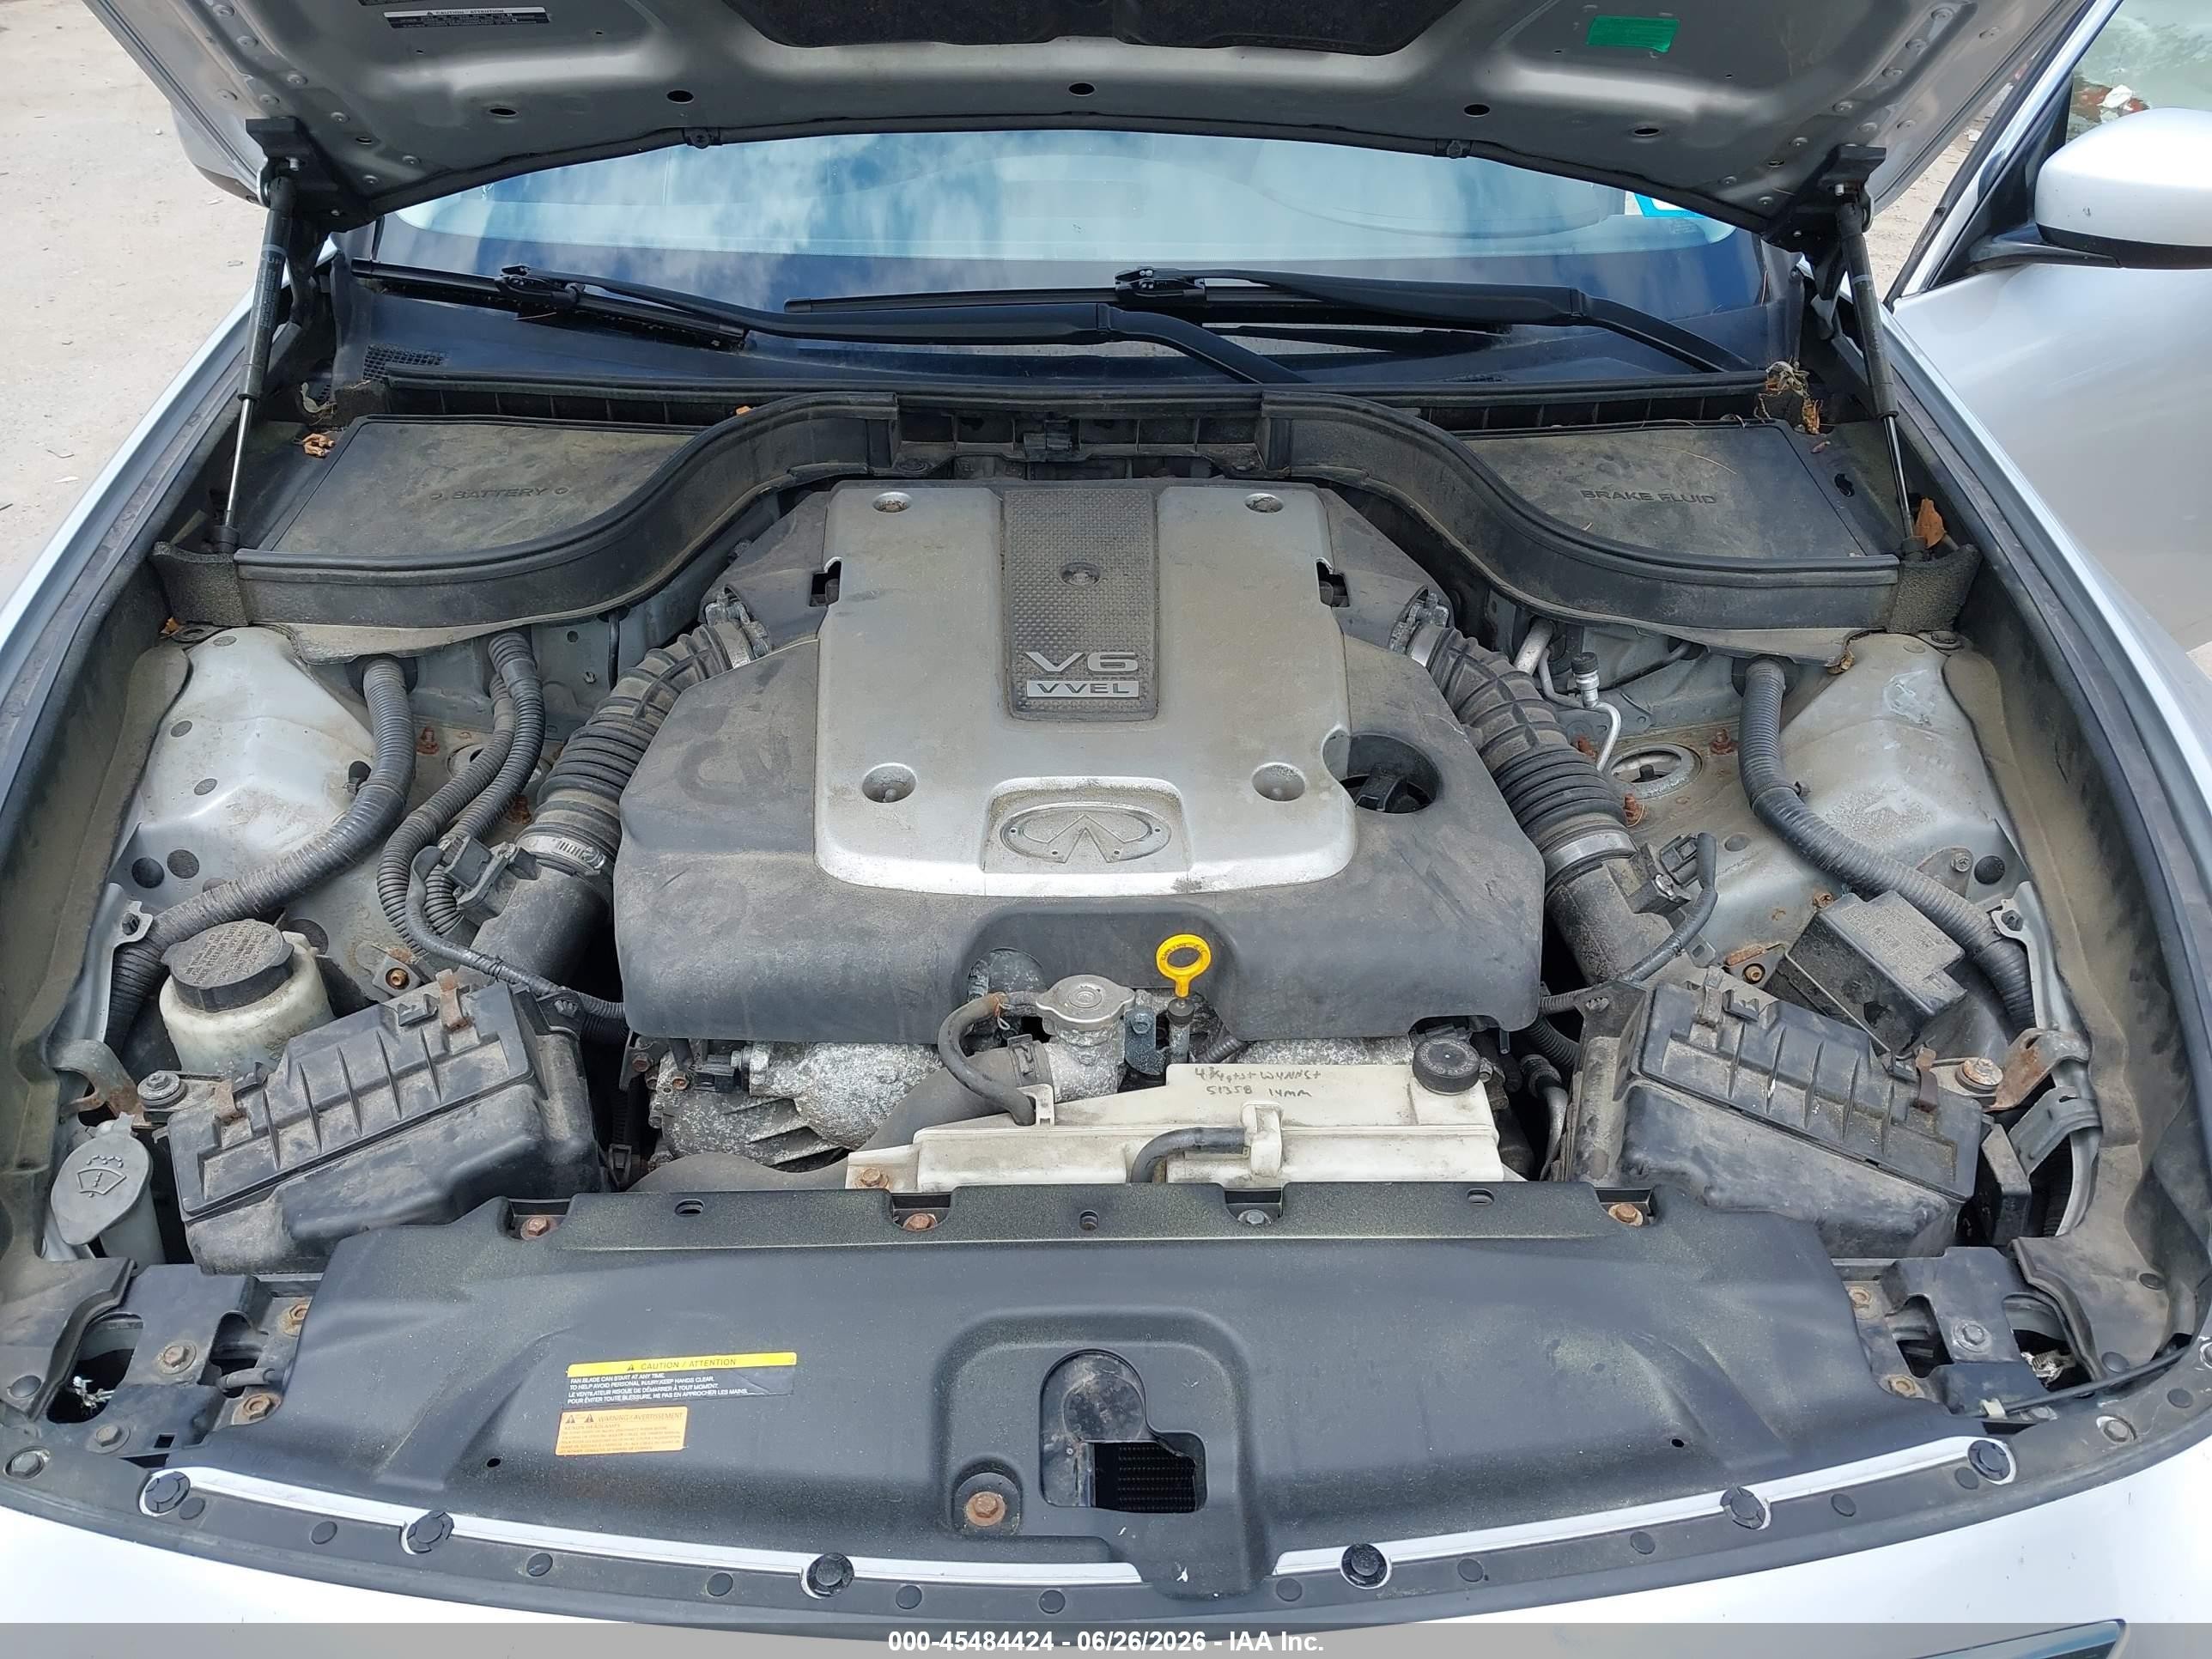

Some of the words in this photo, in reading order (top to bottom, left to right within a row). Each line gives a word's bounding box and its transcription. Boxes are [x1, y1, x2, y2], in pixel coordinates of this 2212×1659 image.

[453, 487, 548, 501] BATTERY
[1580, 489, 1655, 501] BRAKE
[1657, 493, 1717, 505] FLUID
[1023, 651, 1139, 672] V6
[1036, 683, 1130, 694] VVEL
[641, 1361, 679, 1370] CAUTION
[689, 1358, 737, 1368] ATTENTION
[611, 1379, 641, 1388] PERSONAL
[598, 1414, 629, 1423] WARNING
[634, 1413, 683, 1421] AVERTISSEMENT
